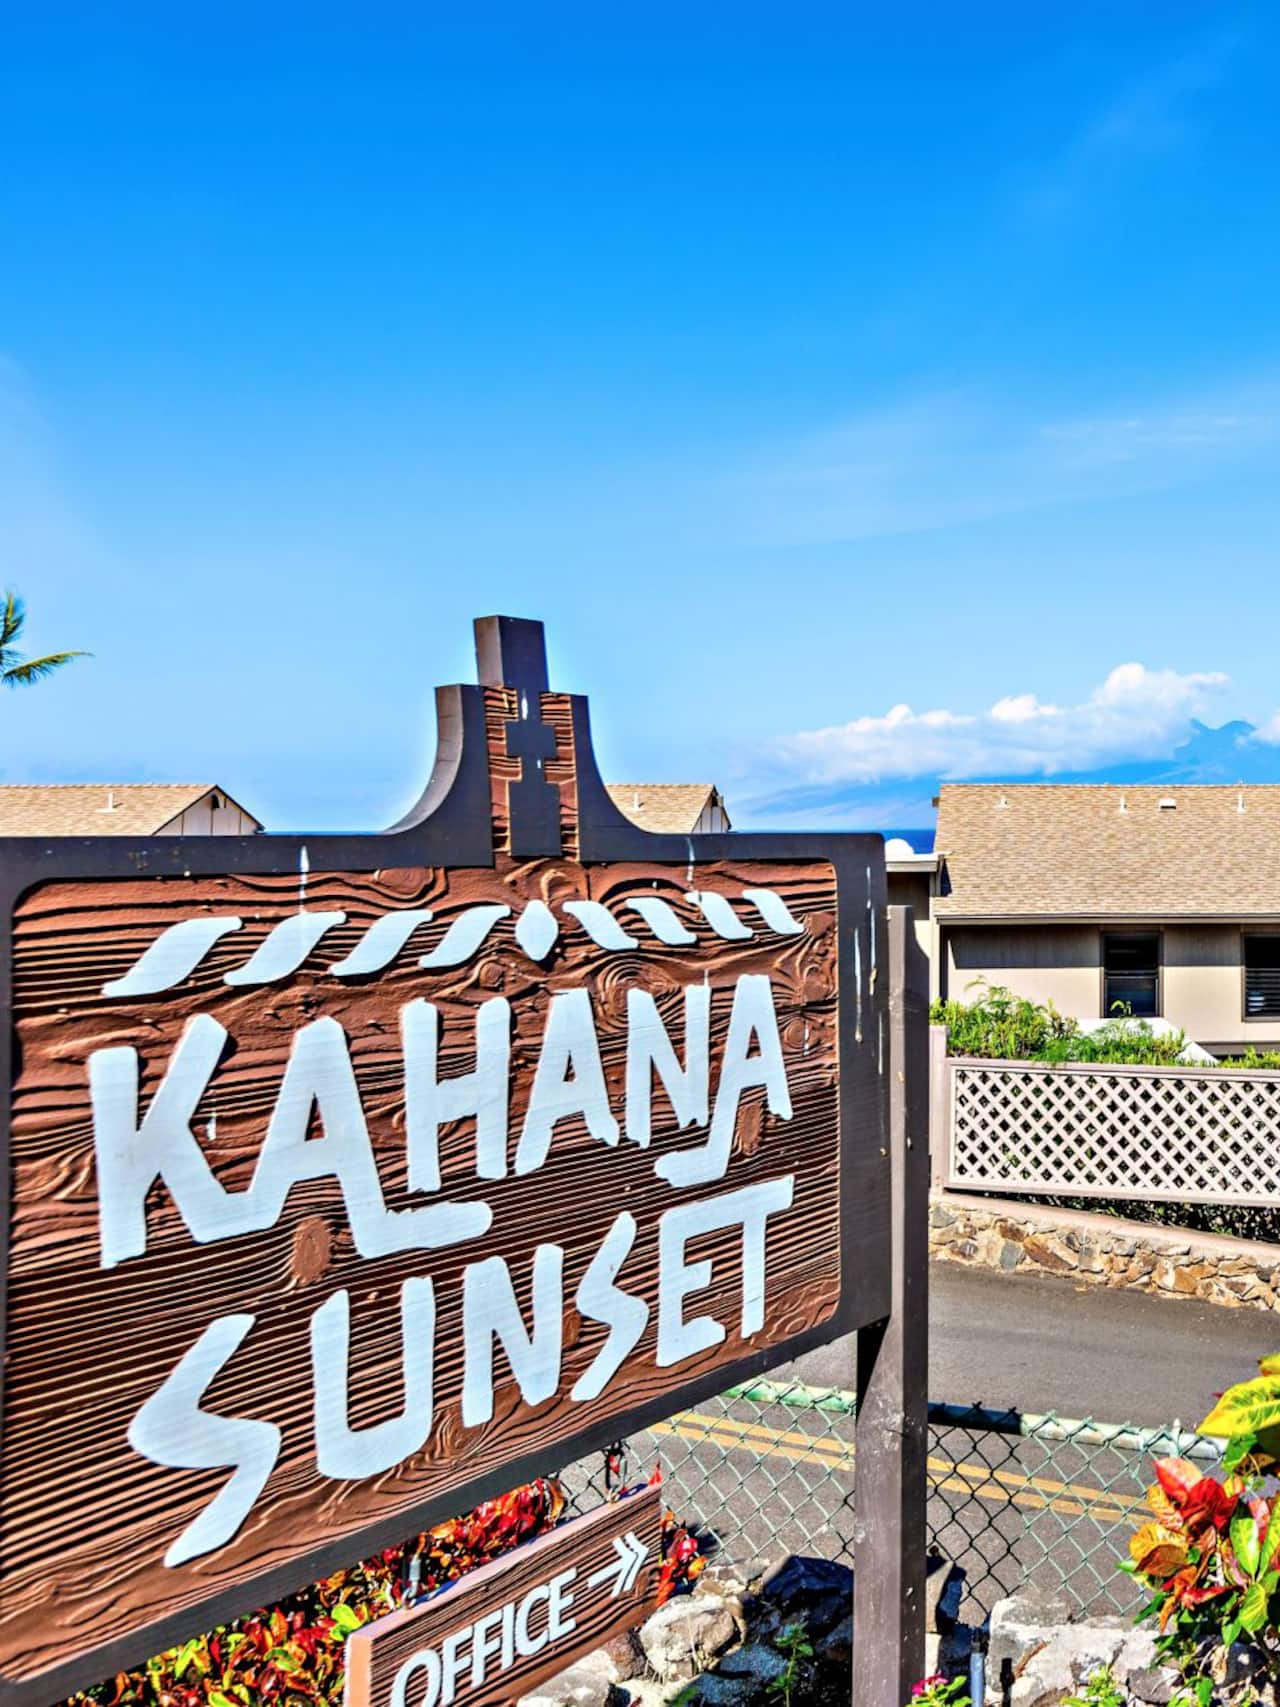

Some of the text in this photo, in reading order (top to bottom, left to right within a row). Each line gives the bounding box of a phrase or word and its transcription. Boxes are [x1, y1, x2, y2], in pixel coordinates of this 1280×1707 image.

[88, 974, 794, 1268] KAHANA
[128, 1176, 795, 1568] SUNSET
[390, 1567, 577, 1707] OFFICE
